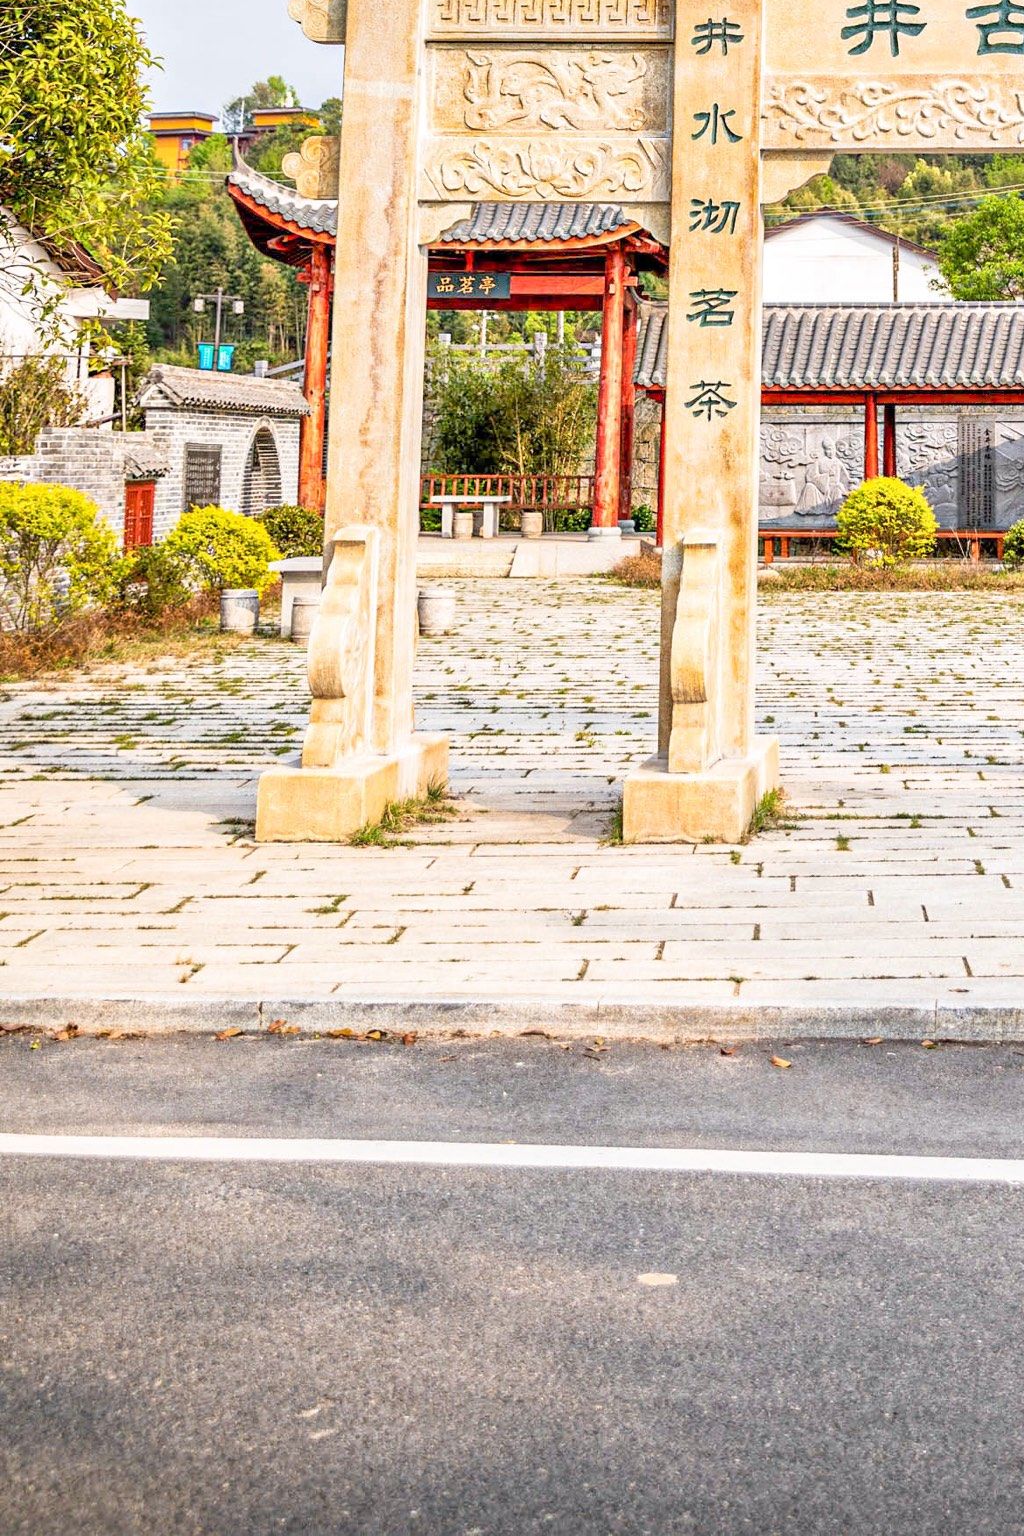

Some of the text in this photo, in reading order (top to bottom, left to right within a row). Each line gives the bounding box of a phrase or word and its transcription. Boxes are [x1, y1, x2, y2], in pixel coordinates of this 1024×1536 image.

[436, 275, 496, 295] 品茗亭
[684, 17, 744, 421] 井水沏茗茶
